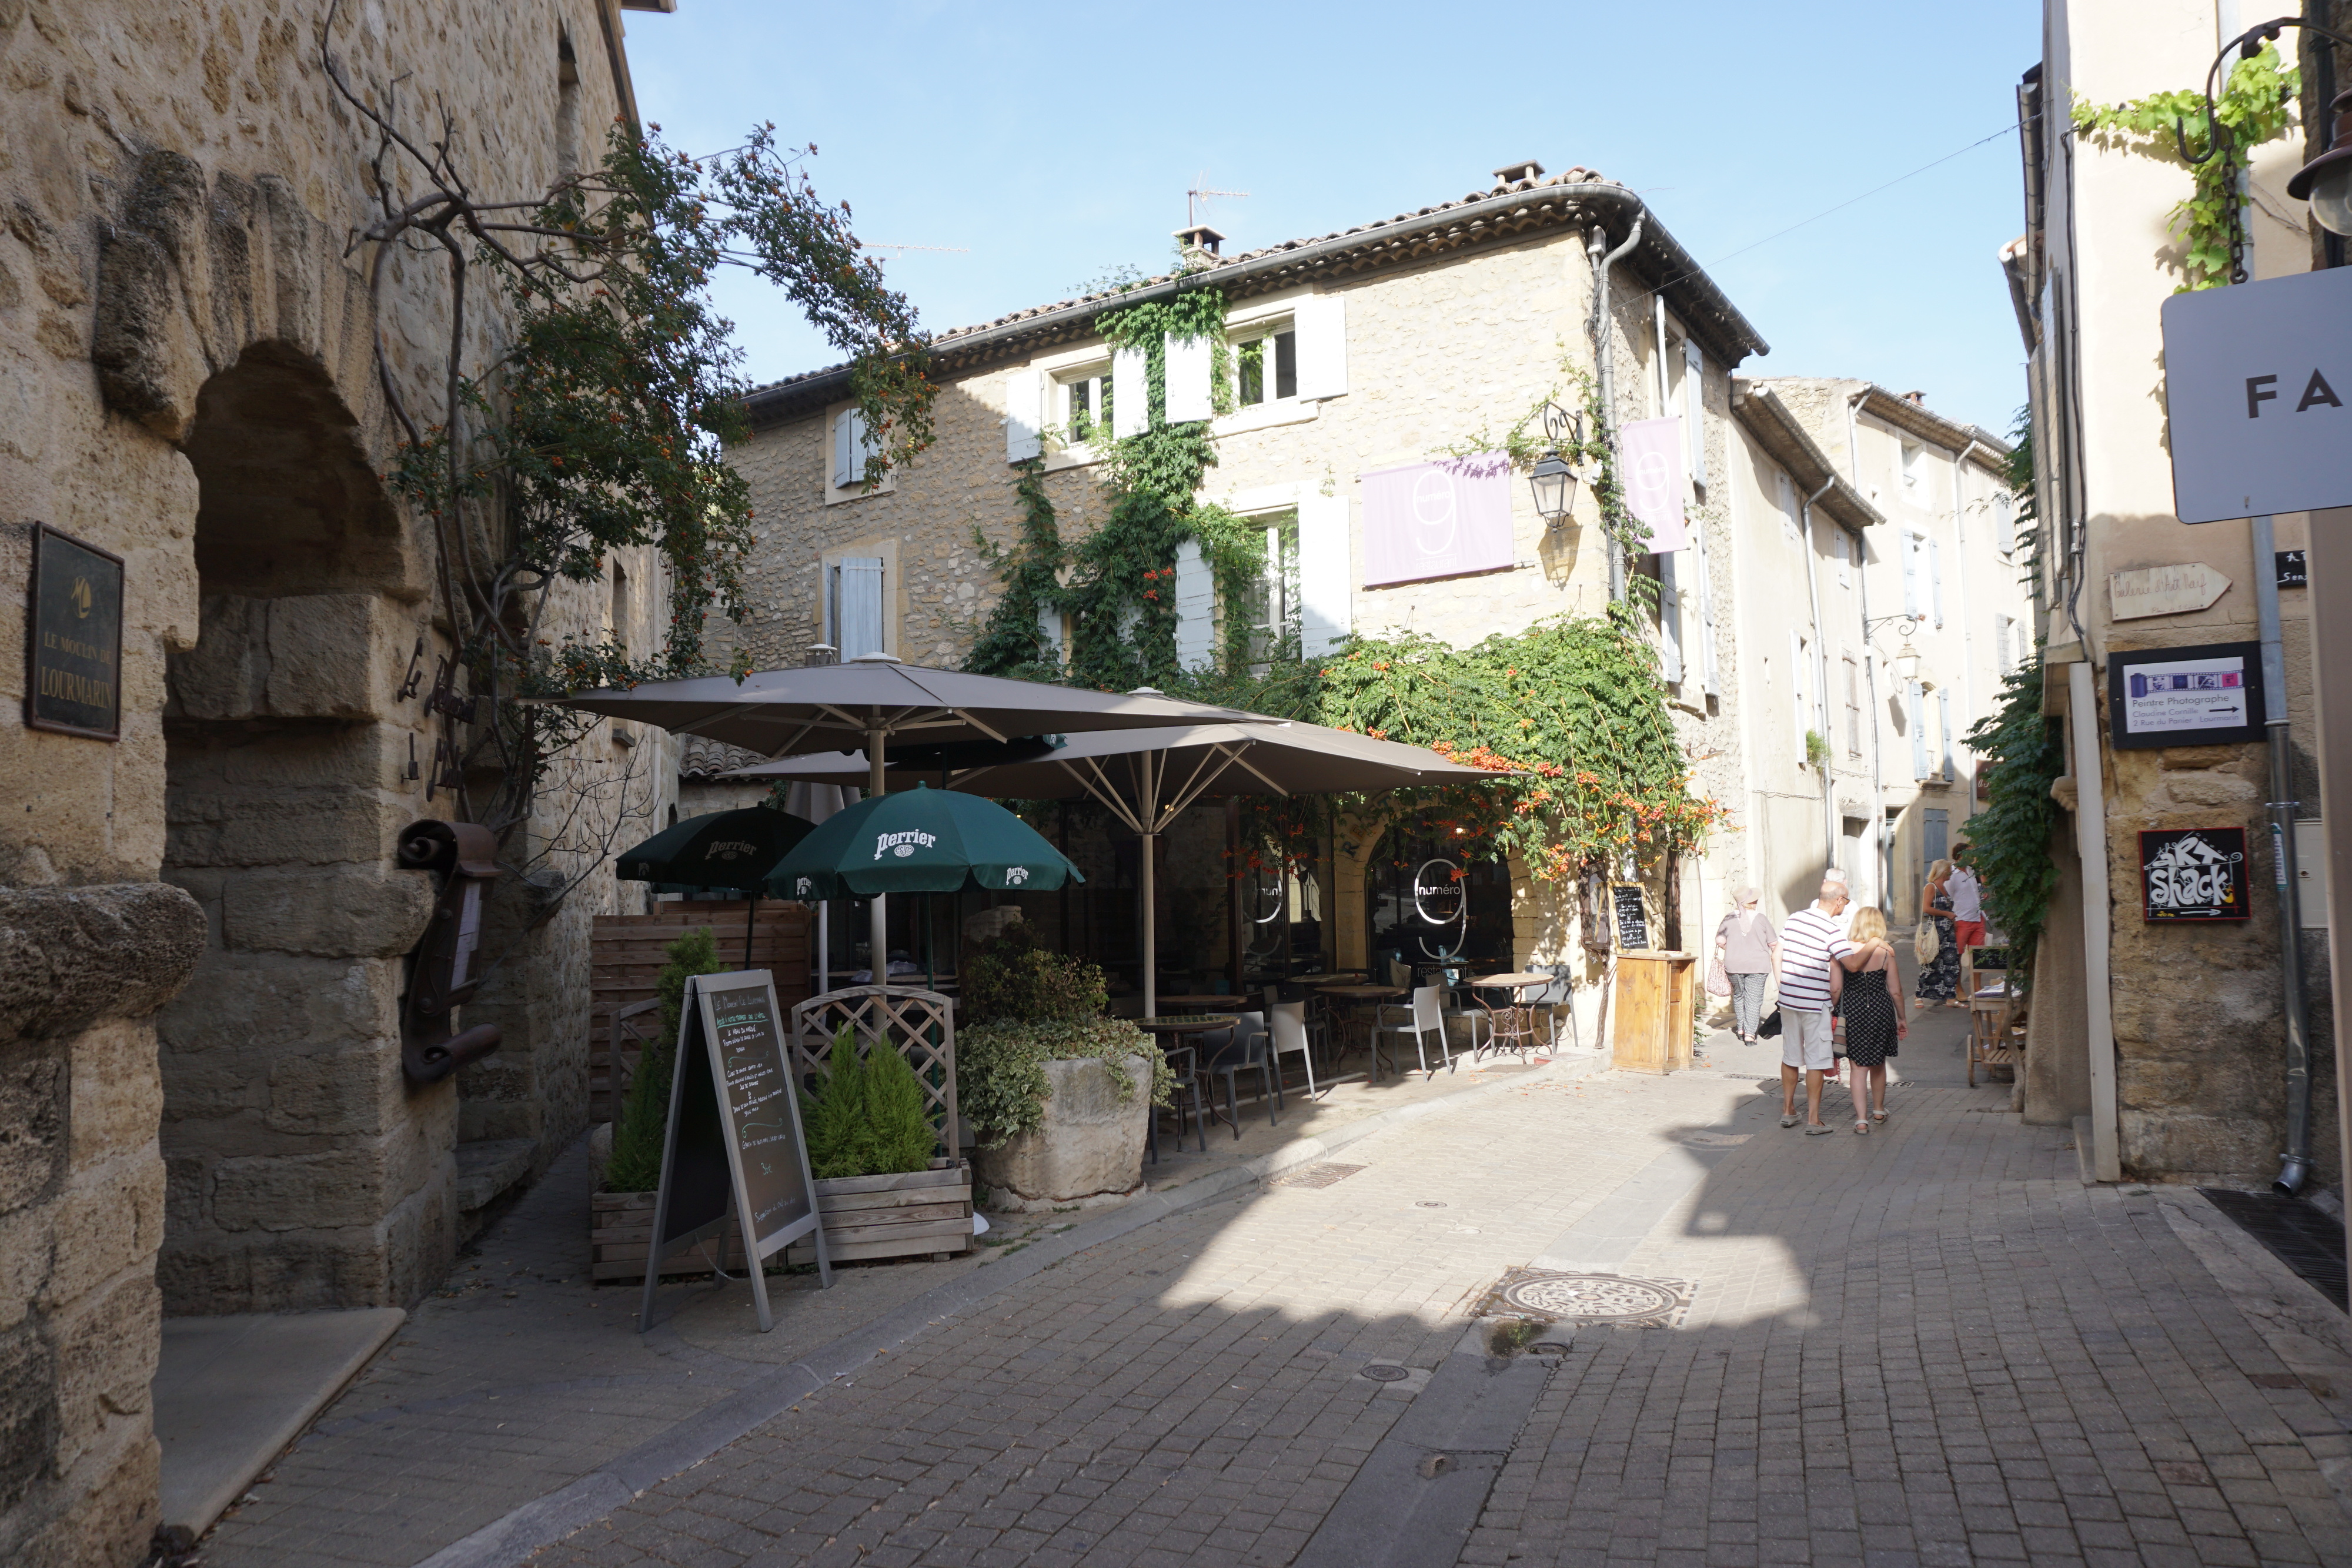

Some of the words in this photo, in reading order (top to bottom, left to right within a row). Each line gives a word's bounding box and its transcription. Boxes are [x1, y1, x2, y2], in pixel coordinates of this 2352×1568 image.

[1416, 487, 1451, 503] numéro
[1416, 556, 1458, 571] restaurant
[2114, 581, 2152, 598] Galerie
[44, 631, 57, 649] LE
[61, 637, 97, 660] MOULIN
[100, 649, 112, 665] DE
[40, 666, 112, 708] LOURMARIN
[2132, 699, 2164, 707] Peintre
[2167, 694, 2229, 706] Photographe
[2133, 709, 2166, 717] Claudine
[2199, 714, 2239, 723] Lourmarin
[704, 840, 757, 860] perrier
[874, 828, 936, 860] perrier
[1005, 865, 1028, 885] perrier
[1419, 884, 1461, 895] numéro
